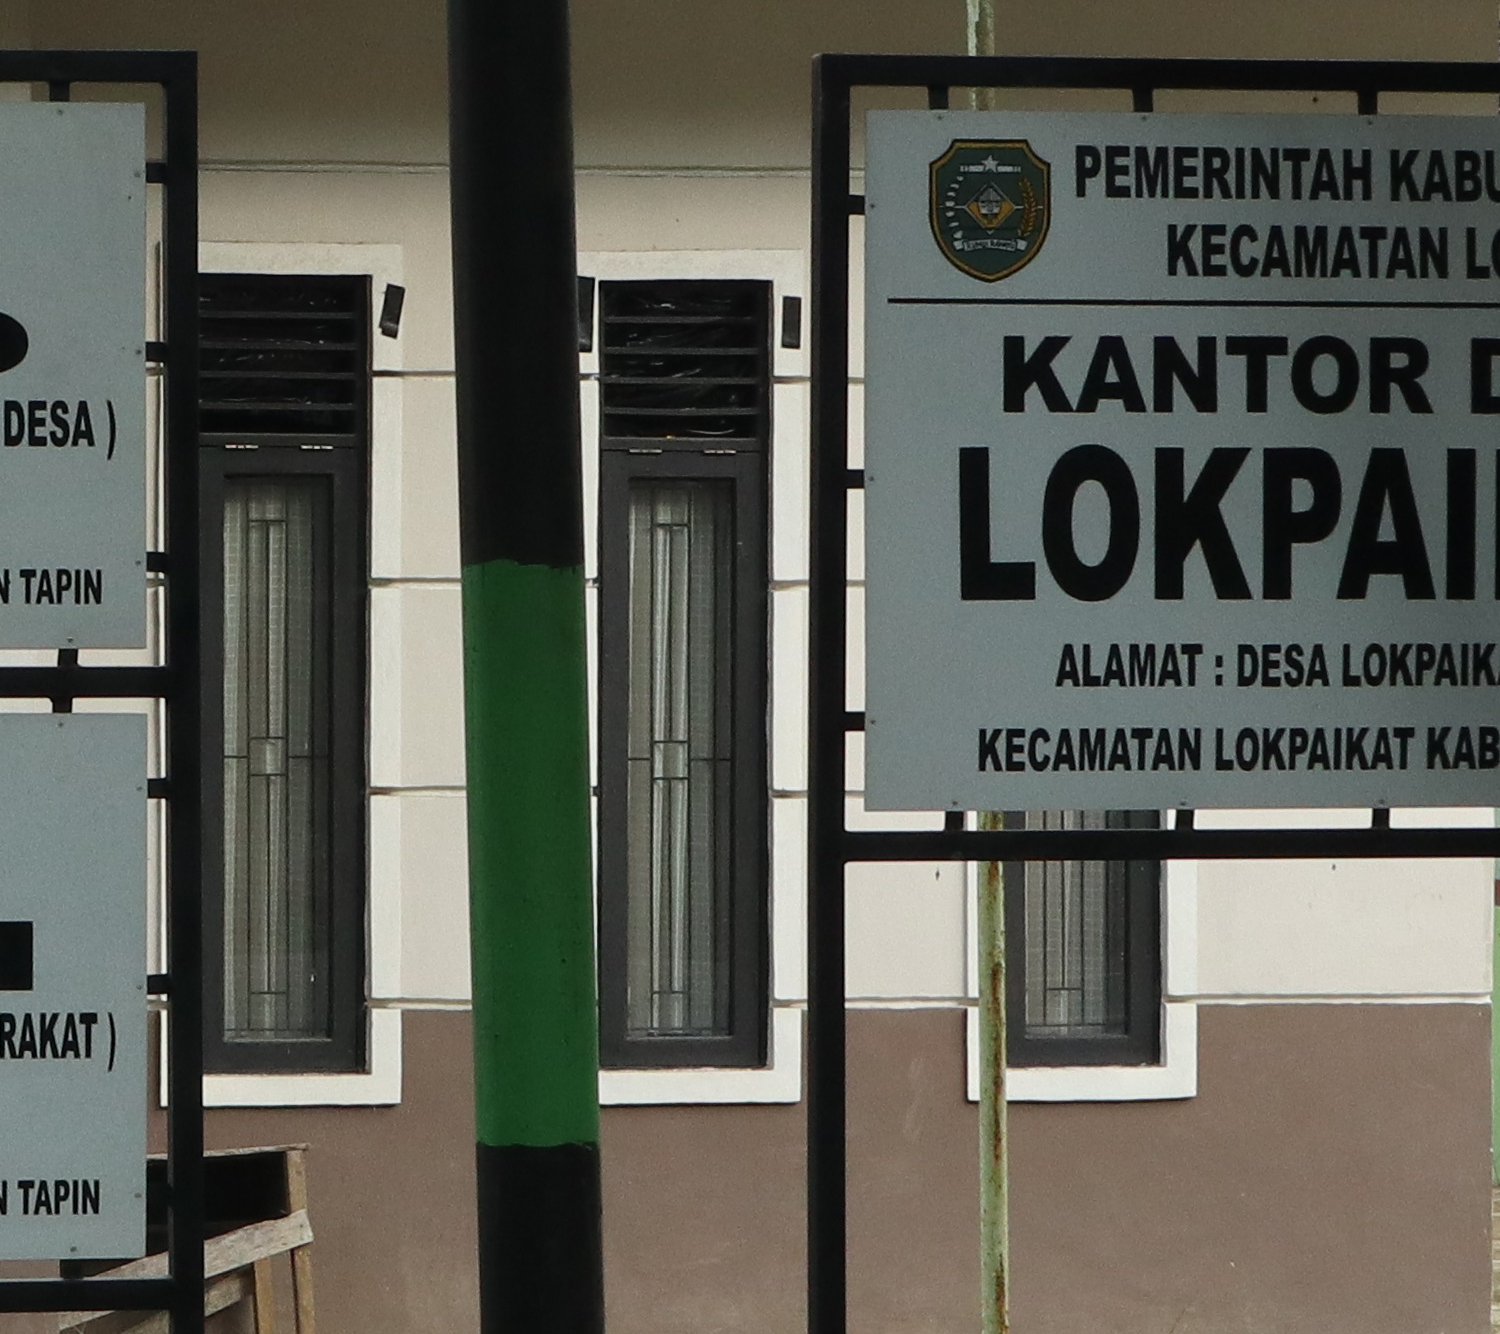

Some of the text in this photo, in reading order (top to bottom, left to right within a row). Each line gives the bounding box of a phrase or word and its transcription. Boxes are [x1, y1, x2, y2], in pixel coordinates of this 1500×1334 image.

[1076, 145, 1372, 201] PEMERINTAH
[1168, 224, 1449, 279] KECAMATAN
[1003, 335, 1434, 415] KANTOR
[20, 569, 101, 604] TAPIN
[1056, 644, 1203, 687] ALAMAT
[1237, 644, 1330, 687] DESA
[979, 728, 1201, 771] KECAMATAN
[1216, 727, 1415, 771] LOKPAIKAT
[18, 1180, 99, 1215] TAPIN
